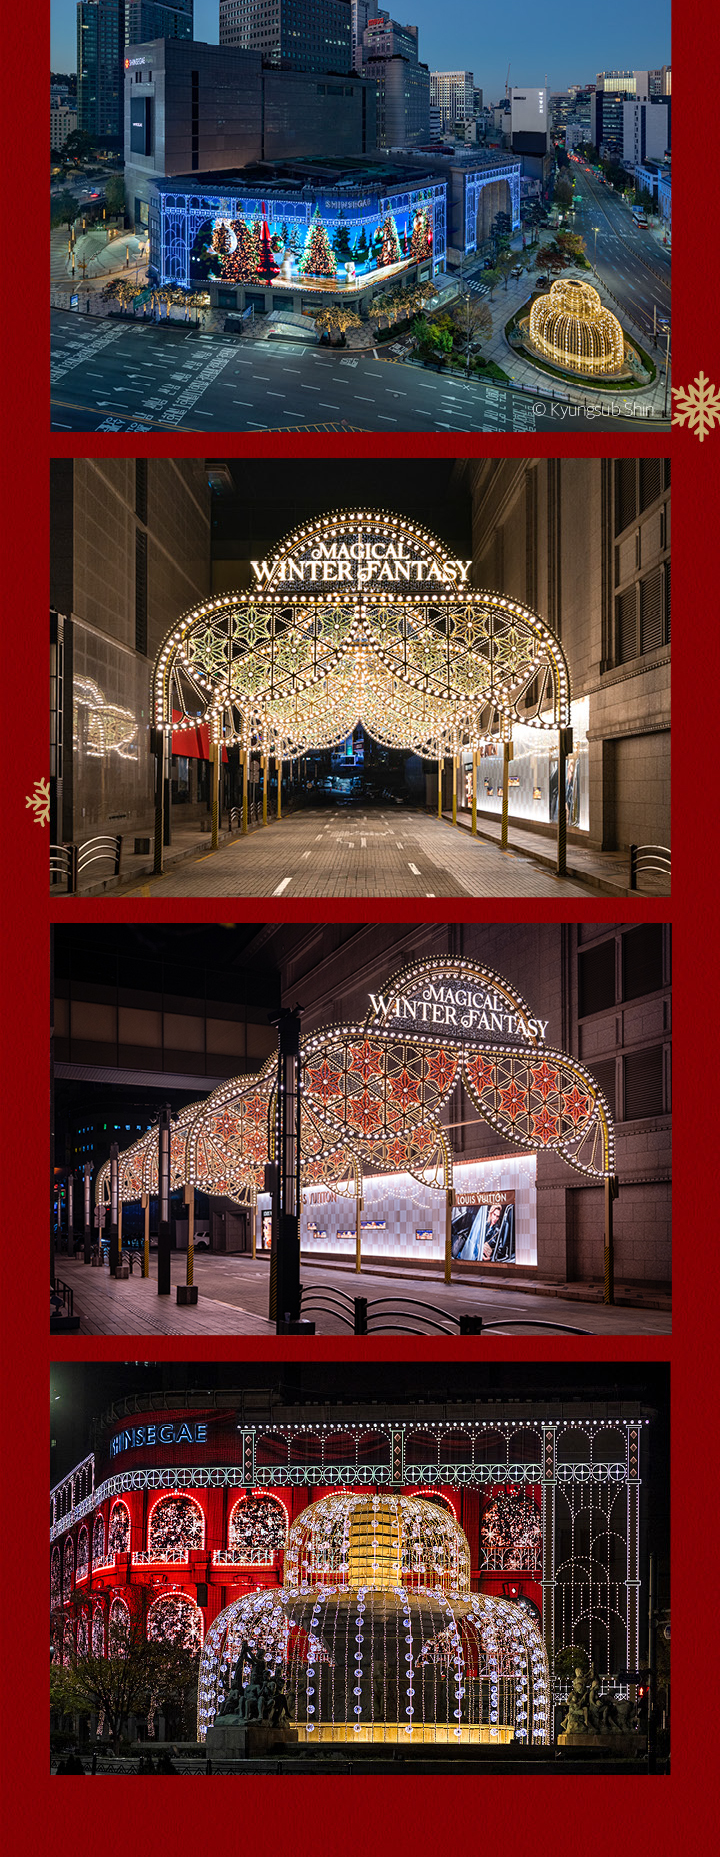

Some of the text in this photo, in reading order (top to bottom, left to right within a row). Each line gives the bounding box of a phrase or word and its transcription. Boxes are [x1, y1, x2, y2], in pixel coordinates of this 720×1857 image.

[325, 197, 371, 209] SHINSEGAE
[311, 542, 410, 560] MAGICAL
[250, 560, 472, 582] WINTER FANTASY
[422, 984, 504, 1012] MAGICAL
[368, 993, 549, 1038] WINTER FANTASY
[457, 1193, 507, 1205] LOUIS VUITTON
[109, 1423, 208, 1459] SHINSEGAE
